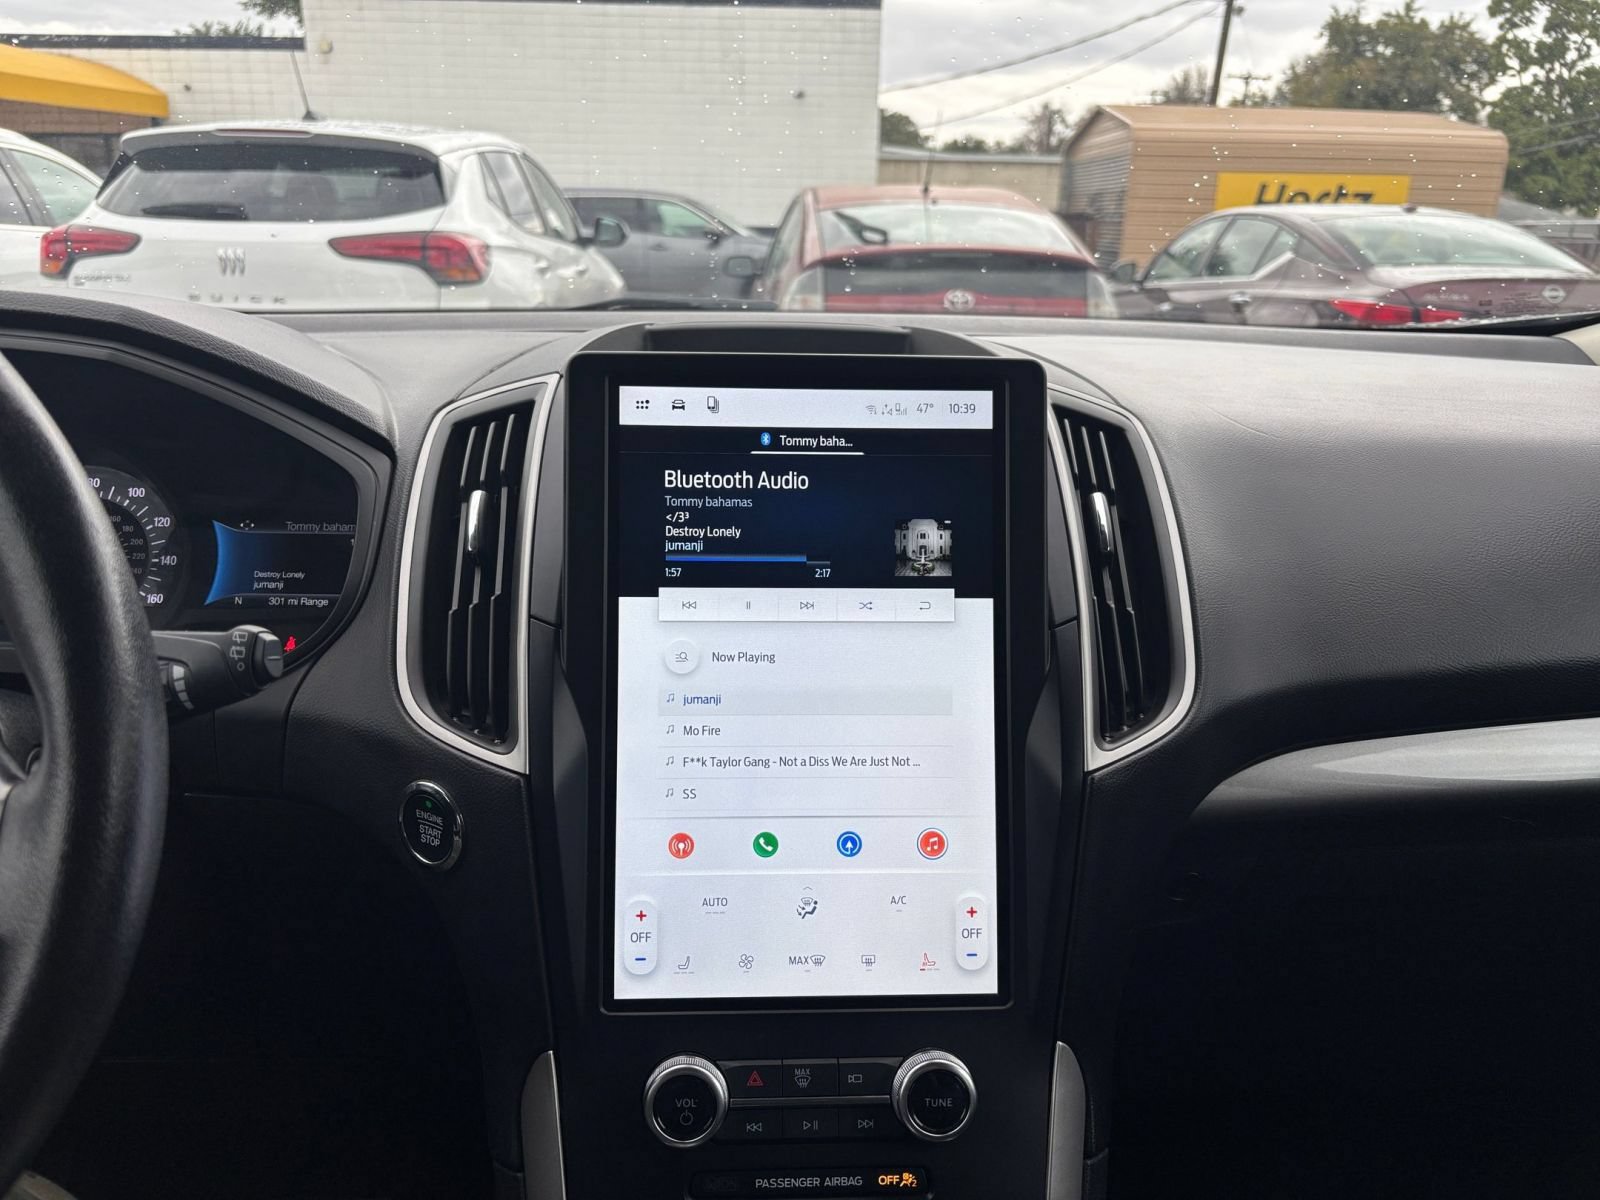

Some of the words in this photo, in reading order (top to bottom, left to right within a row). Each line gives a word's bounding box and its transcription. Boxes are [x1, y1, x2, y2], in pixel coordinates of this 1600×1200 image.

[949, 403, 976, 414] 10:39
[780, 434, 818, 448] Tommy
[820, 435, 853, 447] baha...
[664, 470, 753, 489] Bluetooth
[757, 471, 809, 490] Audio
[128, 487, 145, 498] 100
[664, 495, 703, 508] Tommy
[705, 495, 753, 508] bahamas
[154, 517, 170, 527] 120
[286, 521, 320, 534] Tommy
[665, 525, 704, 538] Destroy
[707, 526, 741, 539] Lonely
[665, 539, 704, 553] jumanji
[132, 552, 145, 560] 220
[160, 555, 177, 566] 140
[254, 570, 280, 579] Destroy
[282, 571, 305, 580] Lonely
[665, 567, 681, 577] 1:57
[815, 568, 831, 578] 2:17
[253, 581, 284, 590] jumanji
[146, 593, 163, 604] 160
[234, 597, 242, 605] N
[268, 597, 284, 605] 301
[287, 597, 298, 605] mi
[300, 598, 328, 607] Range
[712, 652, 735, 663] Now
[738, 652, 776, 665] Playing
[683, 693, 722, 706] jumanji
[683, 725, 700, 737] Mo
[702, 725, 721, 737] Fire
[710, 756, 741, 770] Taylor
[744, 756, 770, 770] Gang
[779, 756, 798, 767] Not
[801, 759, 806, 767] a
[809, 755, 830, 767] Diss
[832, 755, 848, 767] We
[850, 755, 867, 767] Are
[869, 755, 889, 768] Just
[892, 755, 911, 767] Not
[682, 788, 697, 799] SS
[416, 810, 443, 825] ENGINE
[420, 825, 442, 838] START
[421, 834, 441, 847] STOP
[702, 898, 728, 907] AUTO
[890, 896, 907, 905] A/C
[630, 932, 652, 943] OFF
[961, 928, 983, 939] OFF
[788, 956, 809, 966] MAX
[675, 1098, 697, 1108] VOL
[925, 1098, 953, 1108] TUNE
[755, 1177, 821, 1188] PASSENGER
[824, 1176, 863, 1187] AIRBAG
[878, 1175, 899, 1186] OFF
